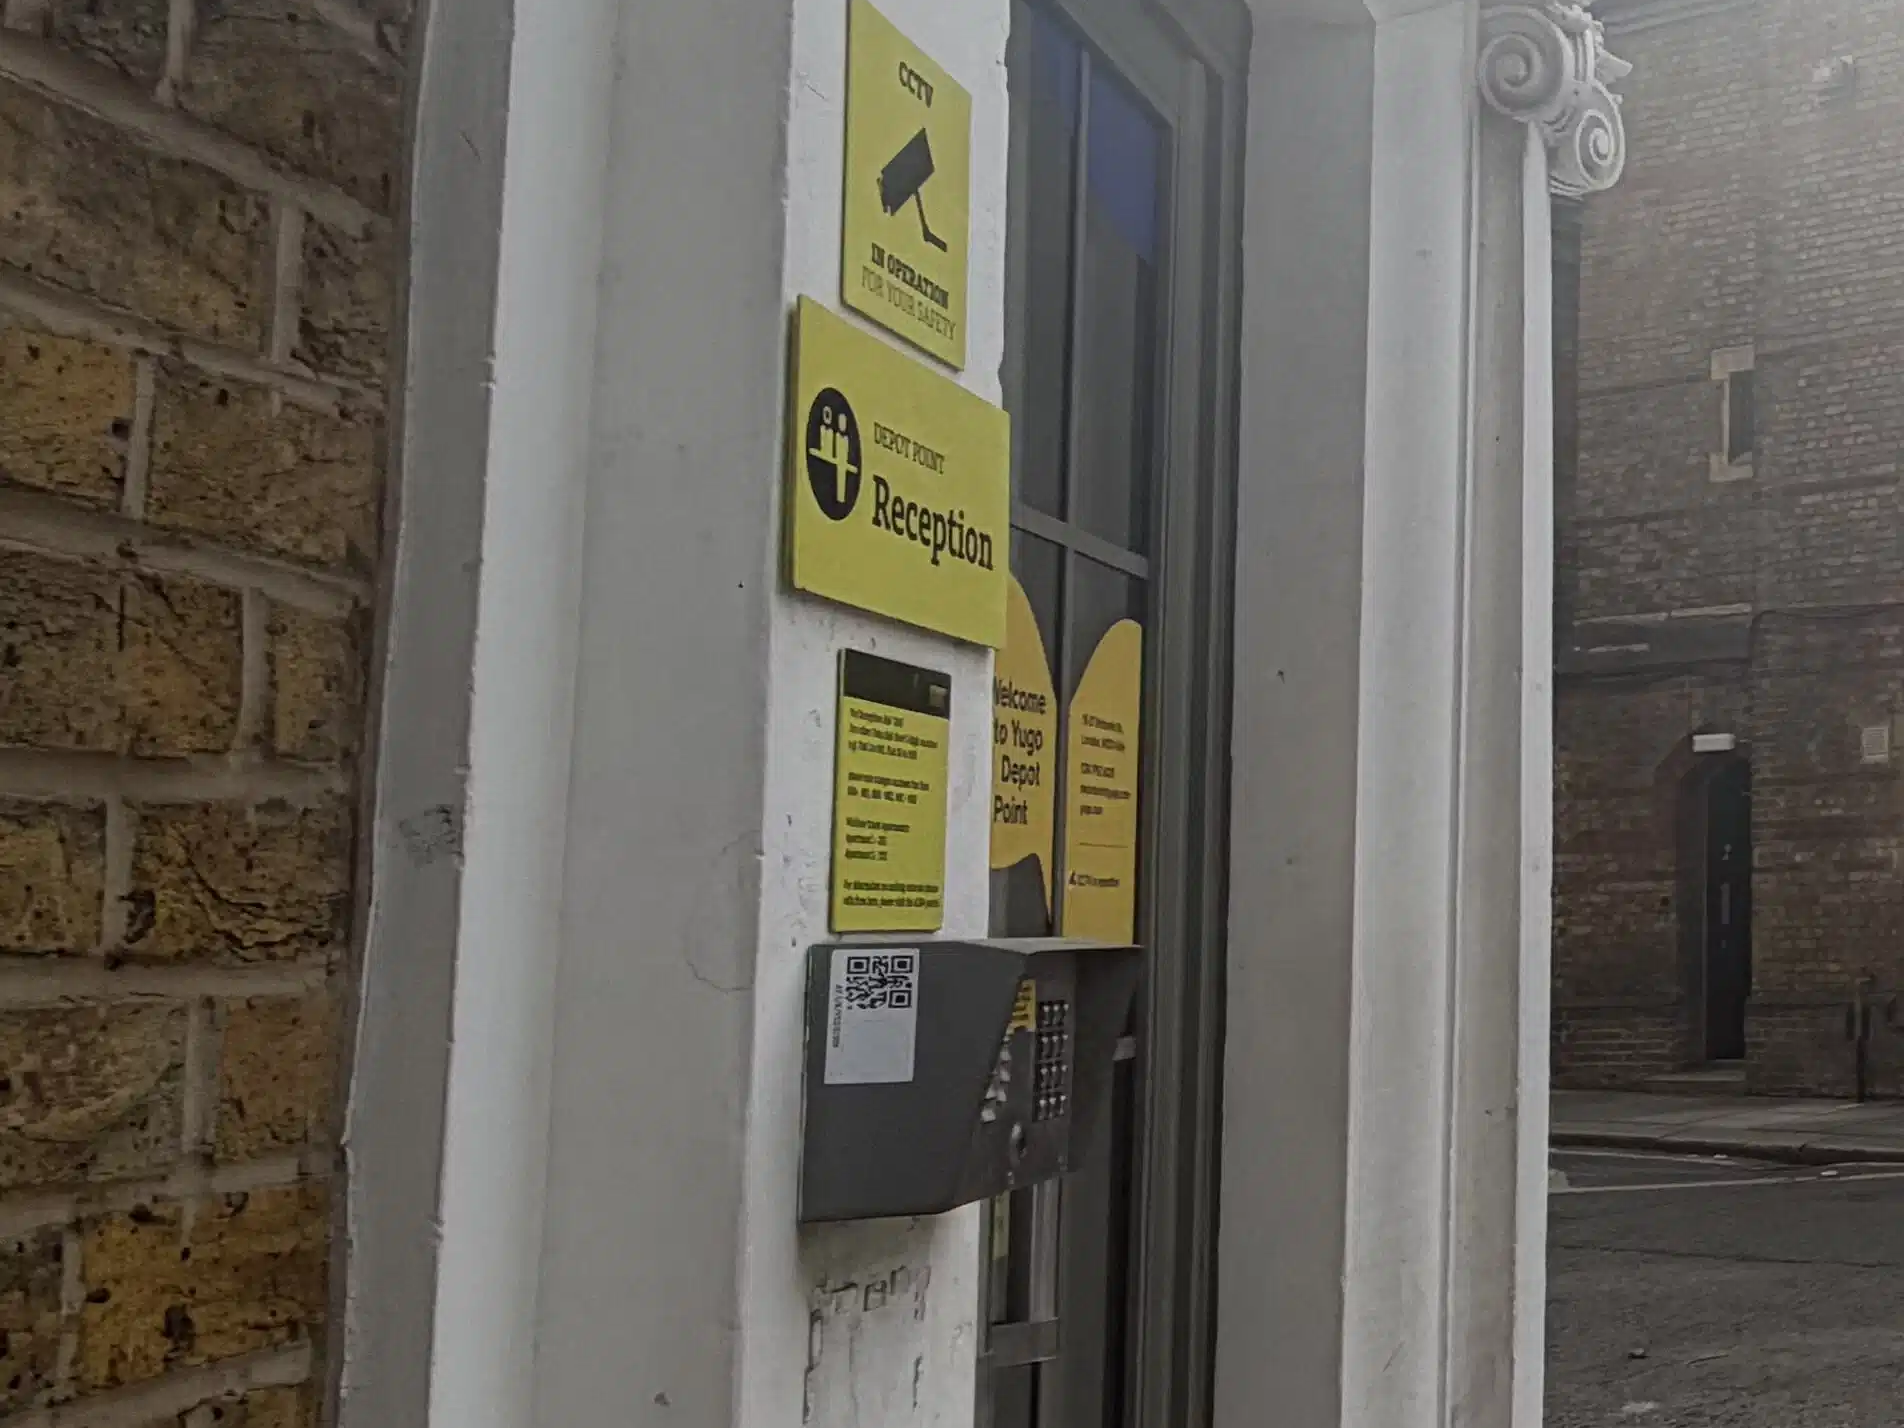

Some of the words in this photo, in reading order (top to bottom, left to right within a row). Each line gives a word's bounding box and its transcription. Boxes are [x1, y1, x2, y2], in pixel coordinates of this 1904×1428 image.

[898, 60, 934, 108] CCTV
[870, 242, 885, 268] IN
[887, 254, 949, 310] OPERATION
[862, 265, 885, 298] FOR
[886, 281, 915, 317] YOUR
[917, 300, 956, 340] SAFETY
[873, 421, 911, 459] DEPOT
[912, 441, 945, 474] POINT
[872, 474, 994, 571] Reception
[994, 717, 1008, 746] to
[1011, 719, 1043, 756] Yugo
[1001, 754, 1040, 792] Depot
[994, 795, 1028, 825] Point
